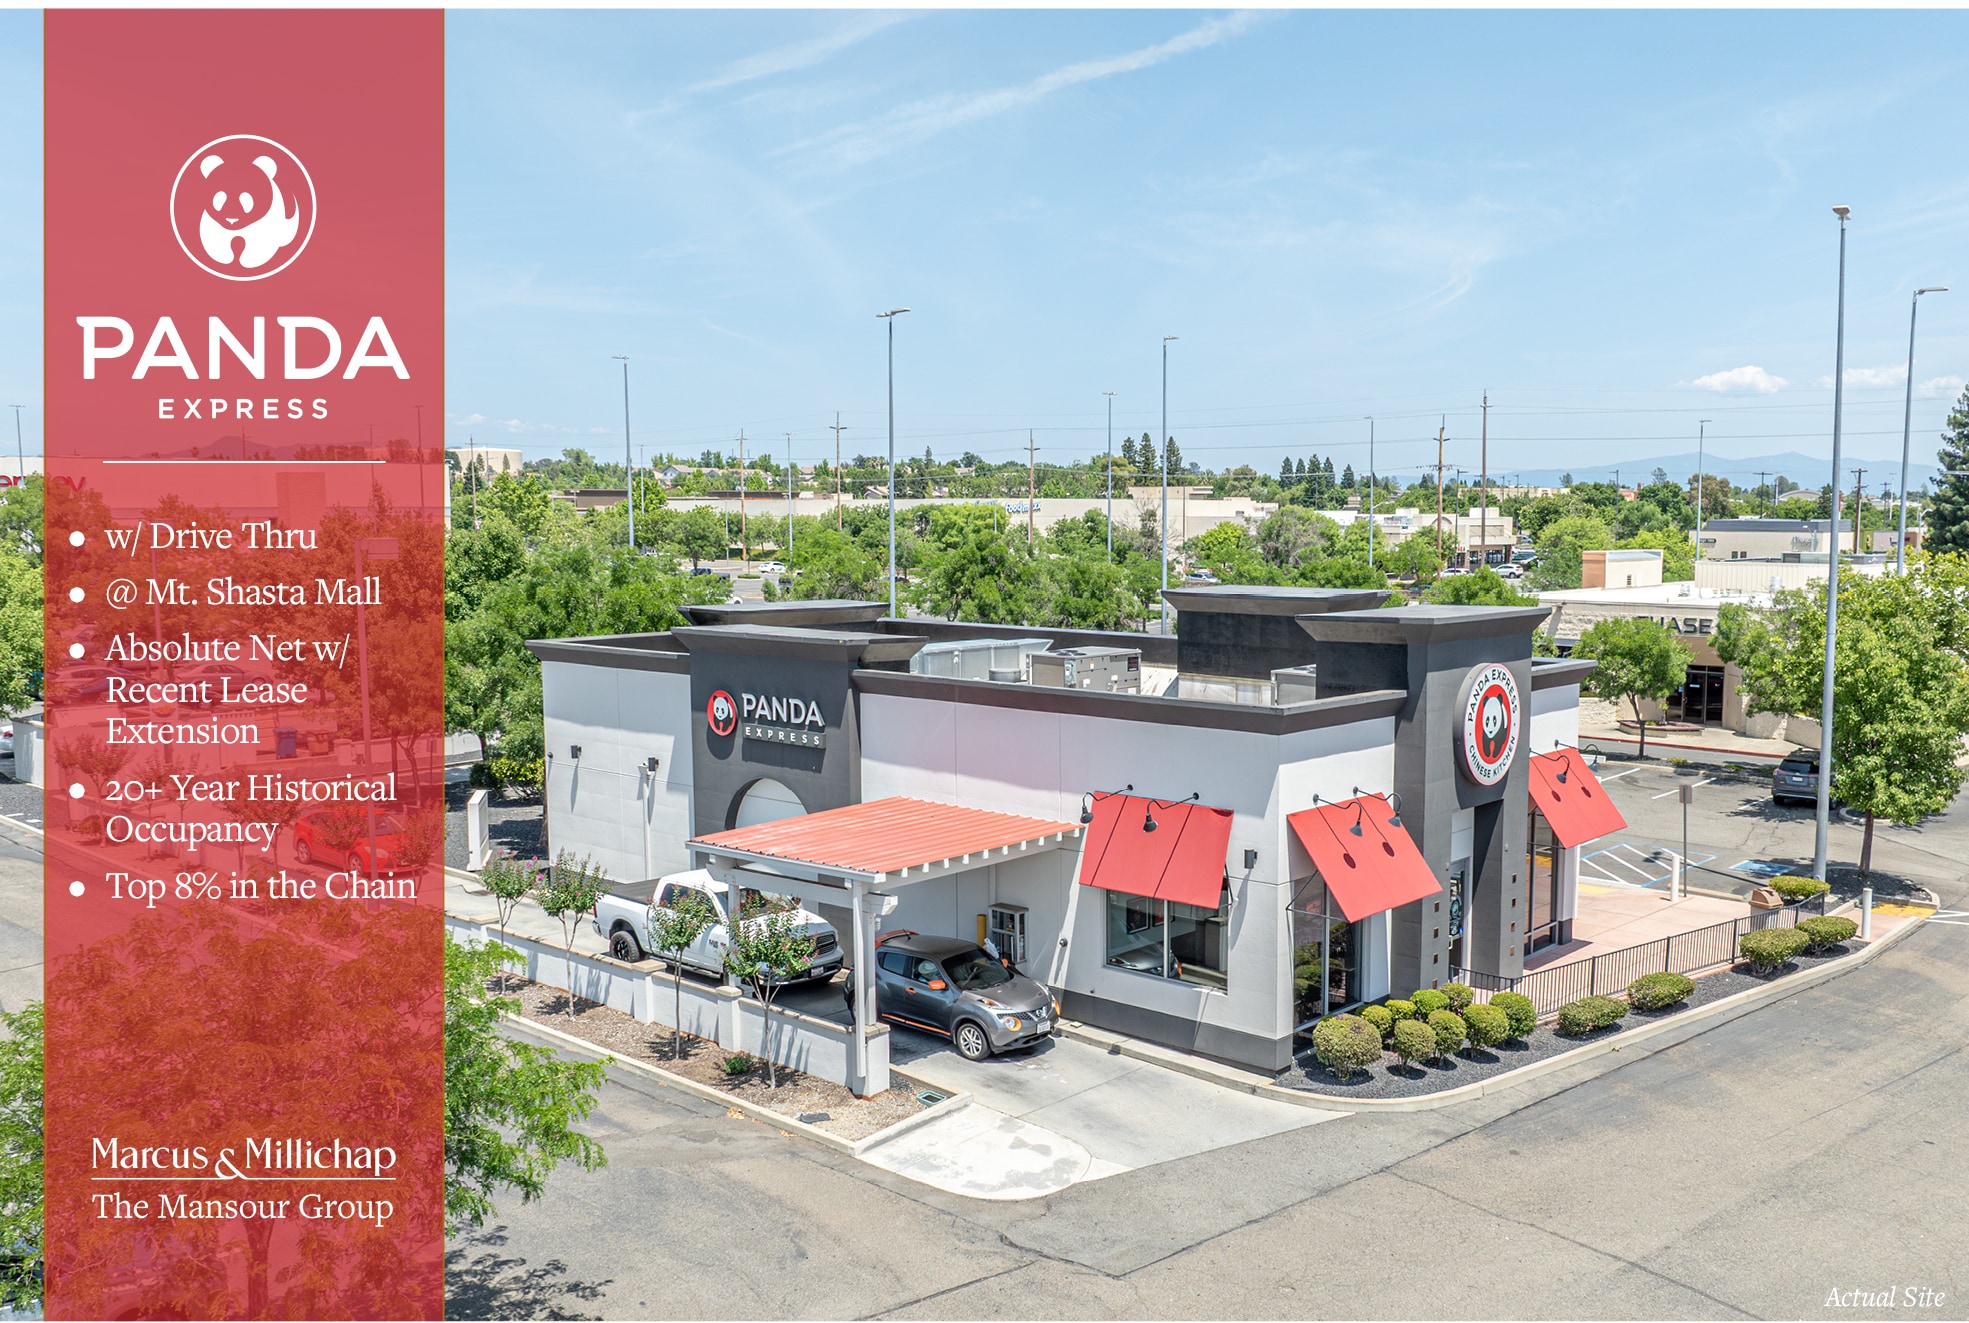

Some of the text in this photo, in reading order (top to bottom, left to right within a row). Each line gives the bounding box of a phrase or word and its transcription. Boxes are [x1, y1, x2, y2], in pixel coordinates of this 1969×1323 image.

[1636, 615, 1713, 634] ASE
[742, 693, 825, 726] PANDA
[1468, 669, 1518, 722] PANDA EXPRESS
[745, 726, 820, 746] EXPRESS
[1469, 736, 1516, 778] CHINESE KITCHEN
